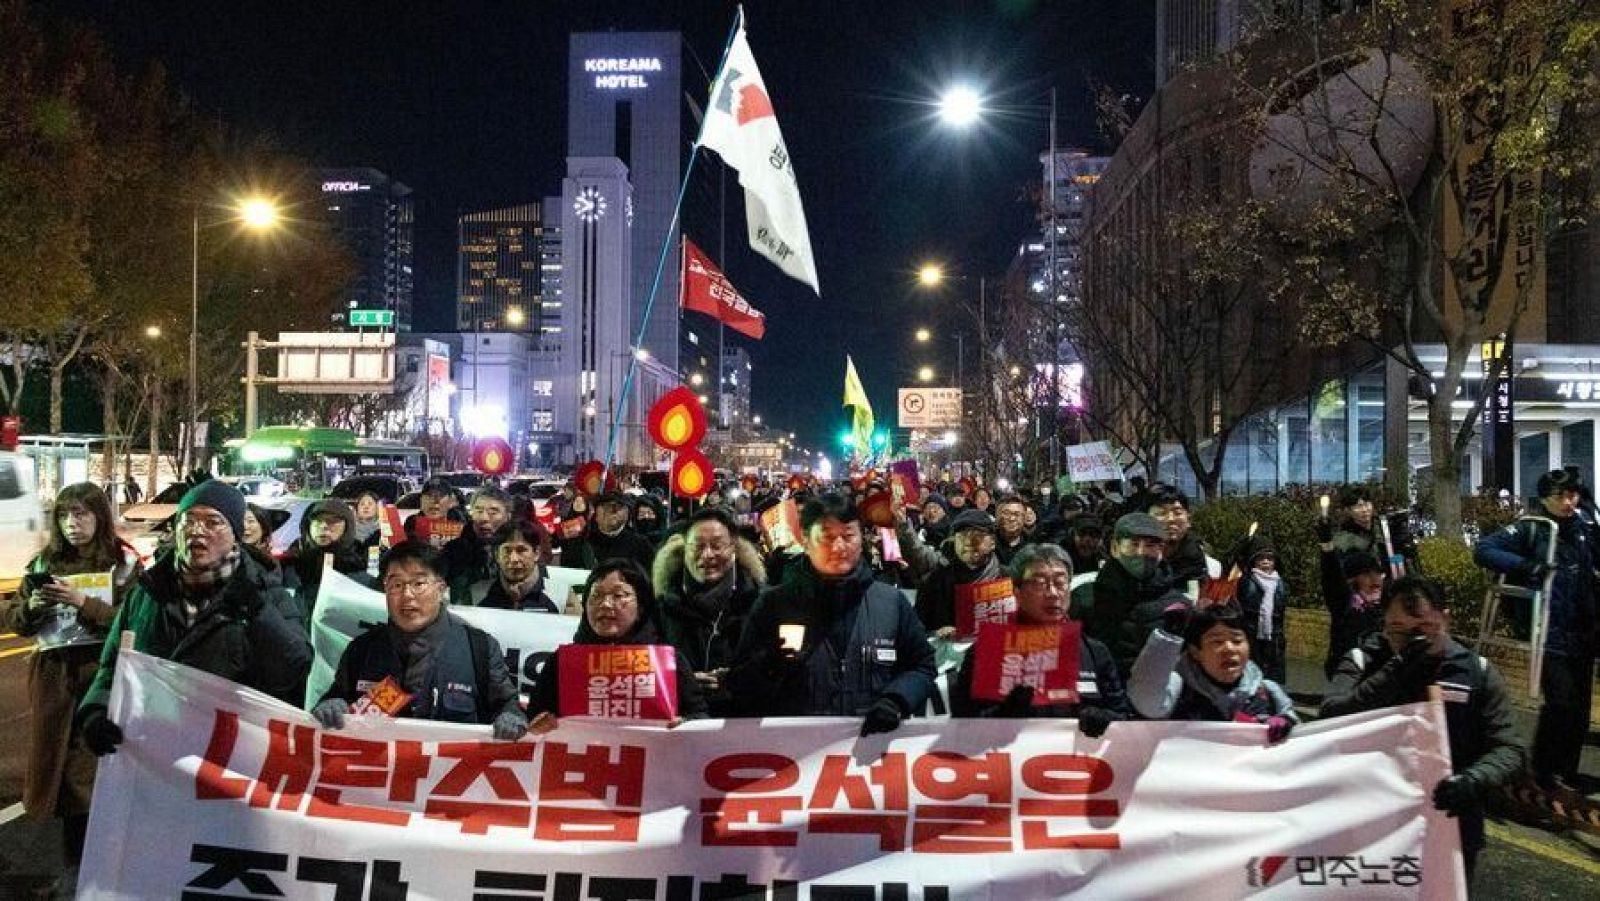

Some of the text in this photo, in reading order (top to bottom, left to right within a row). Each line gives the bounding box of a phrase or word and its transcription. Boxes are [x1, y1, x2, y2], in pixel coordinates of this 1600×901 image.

[584, 57, 661, 72] KOREANA
[595, 75, 648, 89] HOTEL
[588, 649, 656, 674] 내란죄
[1001, 649, 1058, 682] 윤석열
[587, 673, 656, 698] 윤석열
[195, 708, 1121, 854] 내란주범 윤석열은
[1296, 854, 1422, 887] 민주노총
